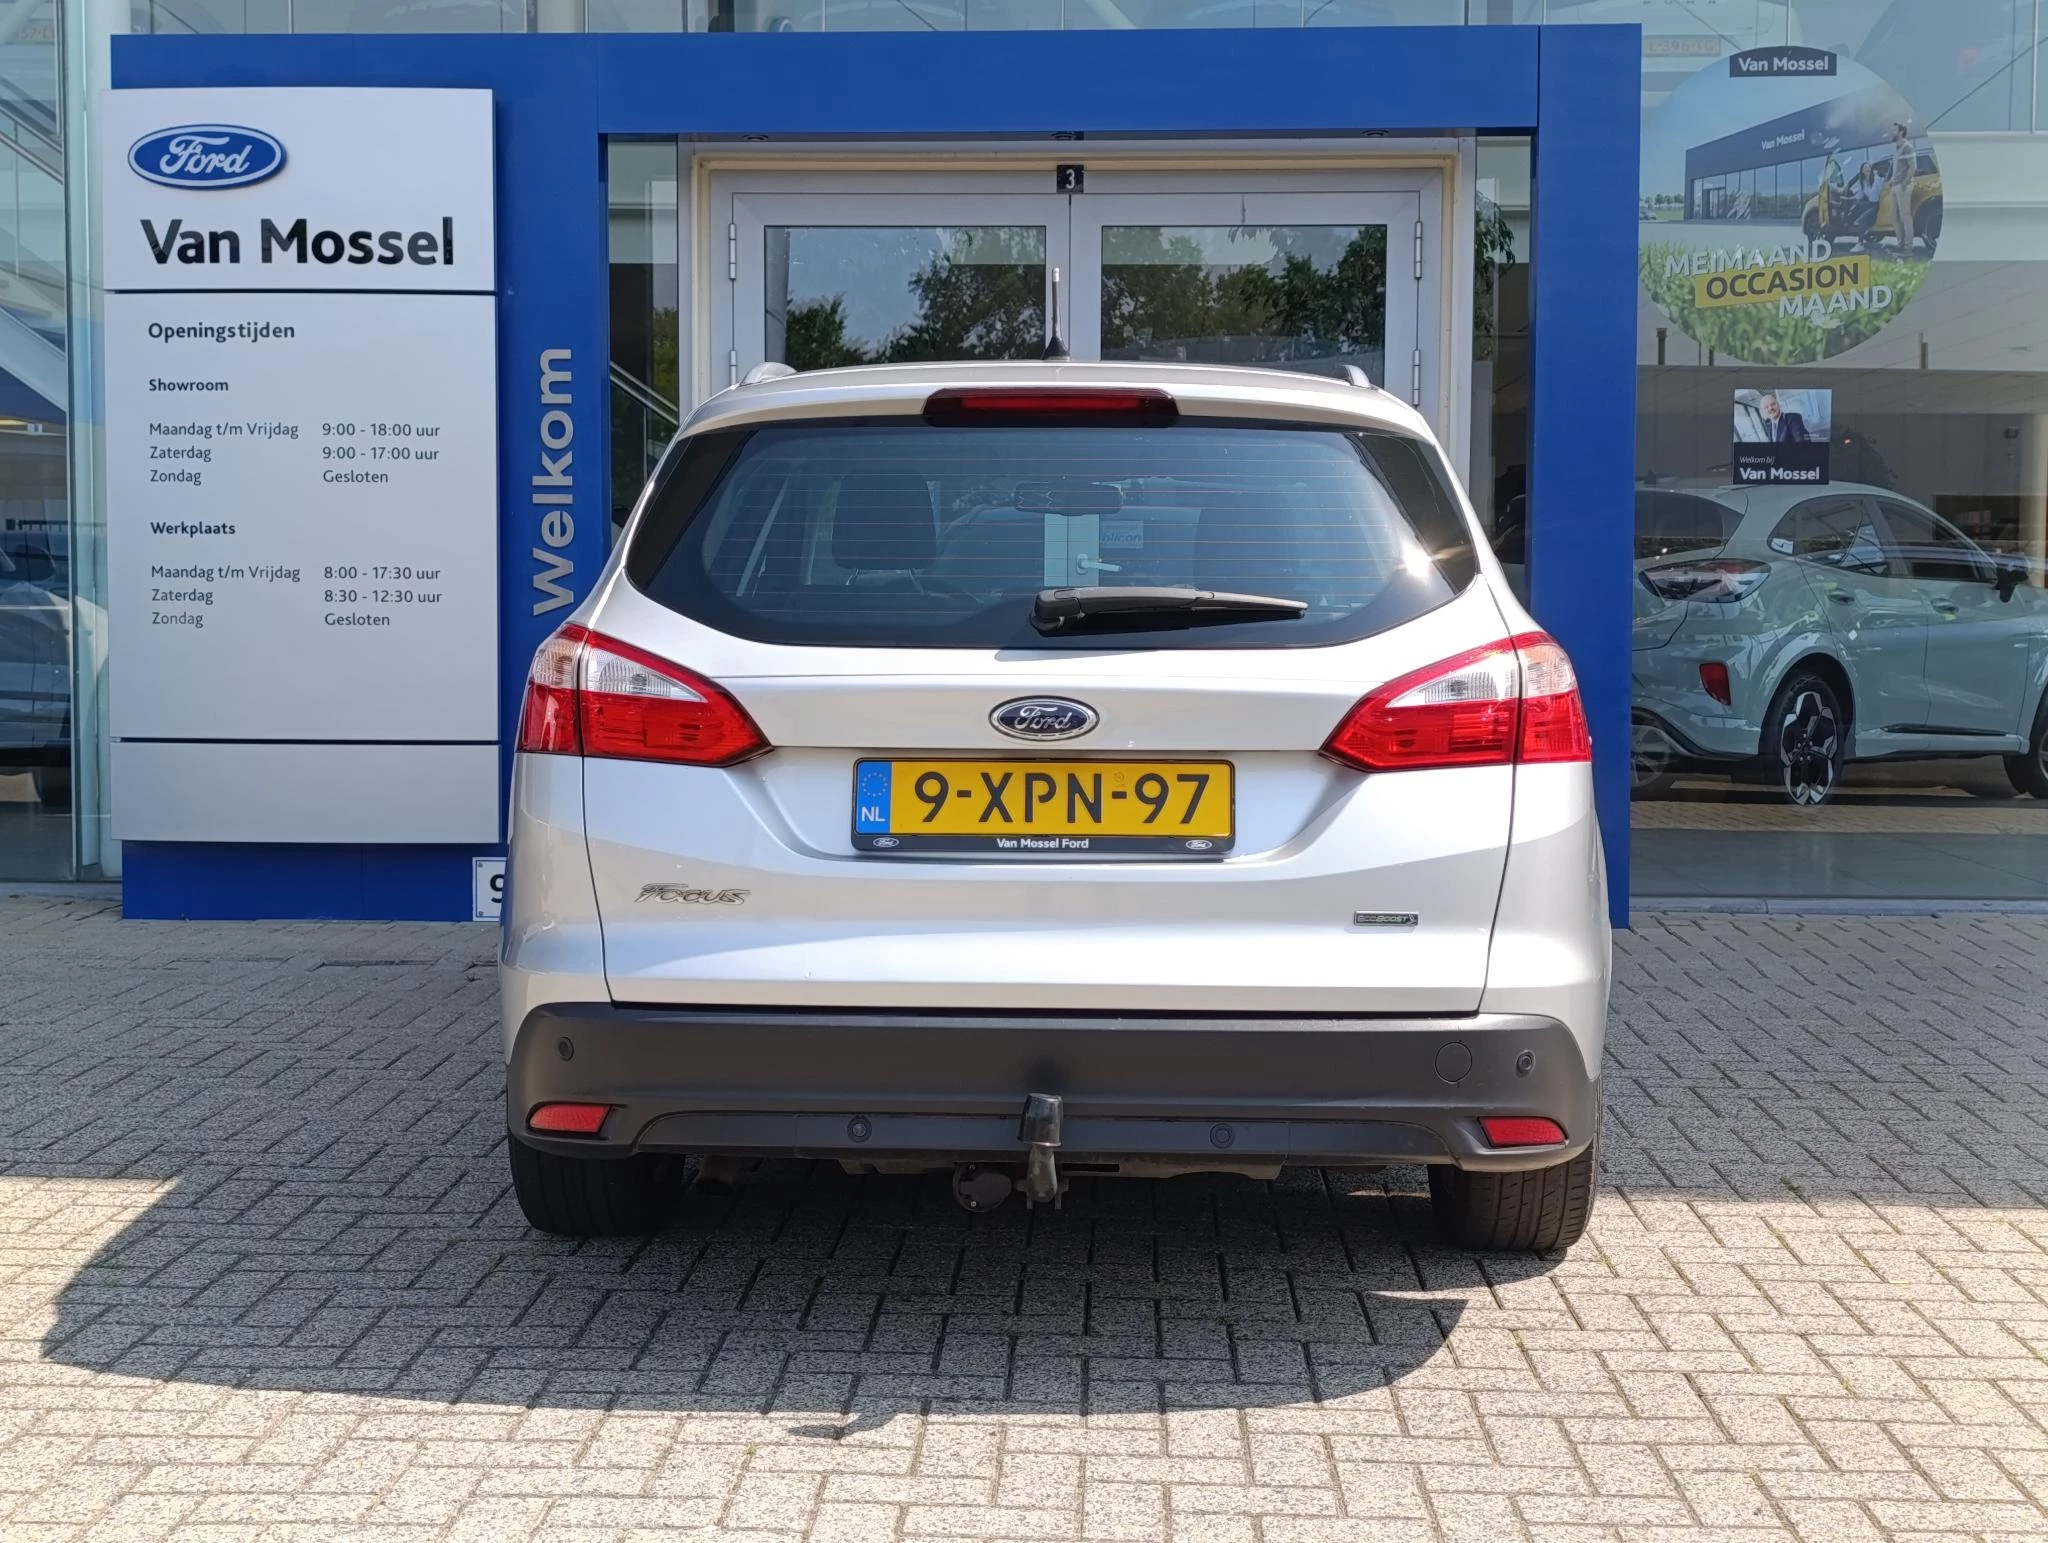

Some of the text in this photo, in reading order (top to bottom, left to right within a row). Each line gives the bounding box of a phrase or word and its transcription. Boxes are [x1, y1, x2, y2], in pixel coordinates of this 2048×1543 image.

[1738, 55, 1829, 72] Van Mossel
[1761, 128, 1805, 151] Van Mossel
[159, 135, 250, 174] Ford
[1065, 168, 1076, 189] 3
[141, 217, 453, 265] Van Mossel
[1664, 238, 1832, 278] MEIMAAND
[1706, 262, 1859, 299] OCCASION
[1779, 286, 1893, 319] MAAND
[149, 322, 294, 343] Openingstijden
[149, 378, 228, 391] Showroom
[150, 422, 298, 440] Maandag t/m Vrijdag
[323, 423, 355, 436] 9:00
[371, 424, 411, 436] 18:00
[417, 428, 440, 436] uur
[150, 446, 211, 463] Zaterdag
[323, 447, 355, 460] 9:00
[371, 447, 410, 460] 17:00
[416, 451, 439, 460] uur
[151, 469, 201, 486] Zondag
[323, 470, 388, 482] Gesloten
[1740, 467, 1820, 480] Van Mossel
[532, 349, 575, 616] Welkom
[151, 521, 235, 538] Werkplaats
[152, 565, 300, 582] Maandag t/m Vrijdag
[325, 567, 357, 579] 8:00
[373, 567, 411, 579] 17:30
[417, 571, 440, 579] uur
[152, 588, 213, 605] Zaterdag
[325, 590, 357, 602] 8:30
[373, 590, 413, 602] 12:30
[418, 594, 442, 603] uur
[152, 612, 203, 628] Zondag
[325, 613, 389, 625] Gesloten
[1014, 706, 1073, 730] Ford
[914, 770, 1210, 825] 9-XPN-97
[861, 807, 885, 822] NL
[996, 838, 1089, 849] Van Mossel Ford
